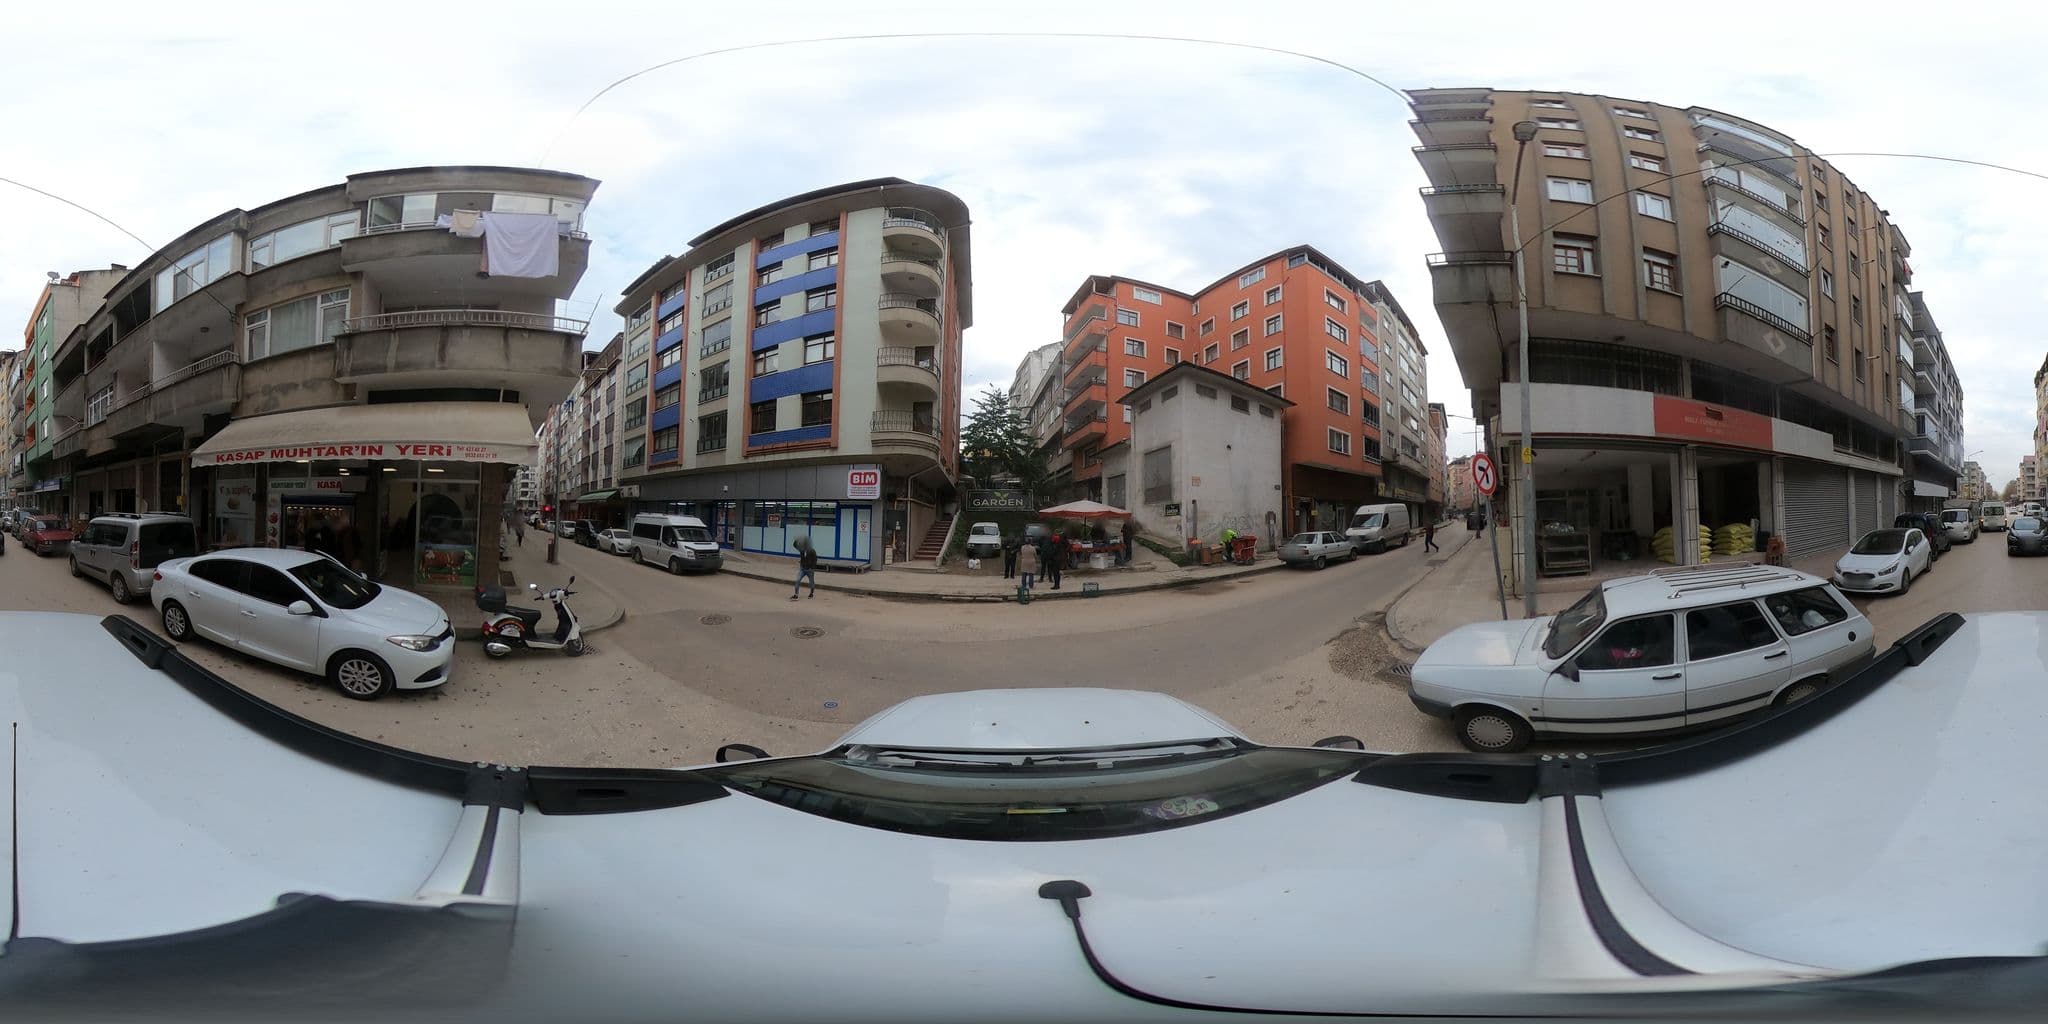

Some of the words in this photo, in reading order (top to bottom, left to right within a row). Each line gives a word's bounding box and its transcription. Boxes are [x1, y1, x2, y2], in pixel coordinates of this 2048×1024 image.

[216, 451, 265, 463] KASAP
[270, 445, 384, 458] MUHTAR'IN
[317, 481, 343, 489] KASA
